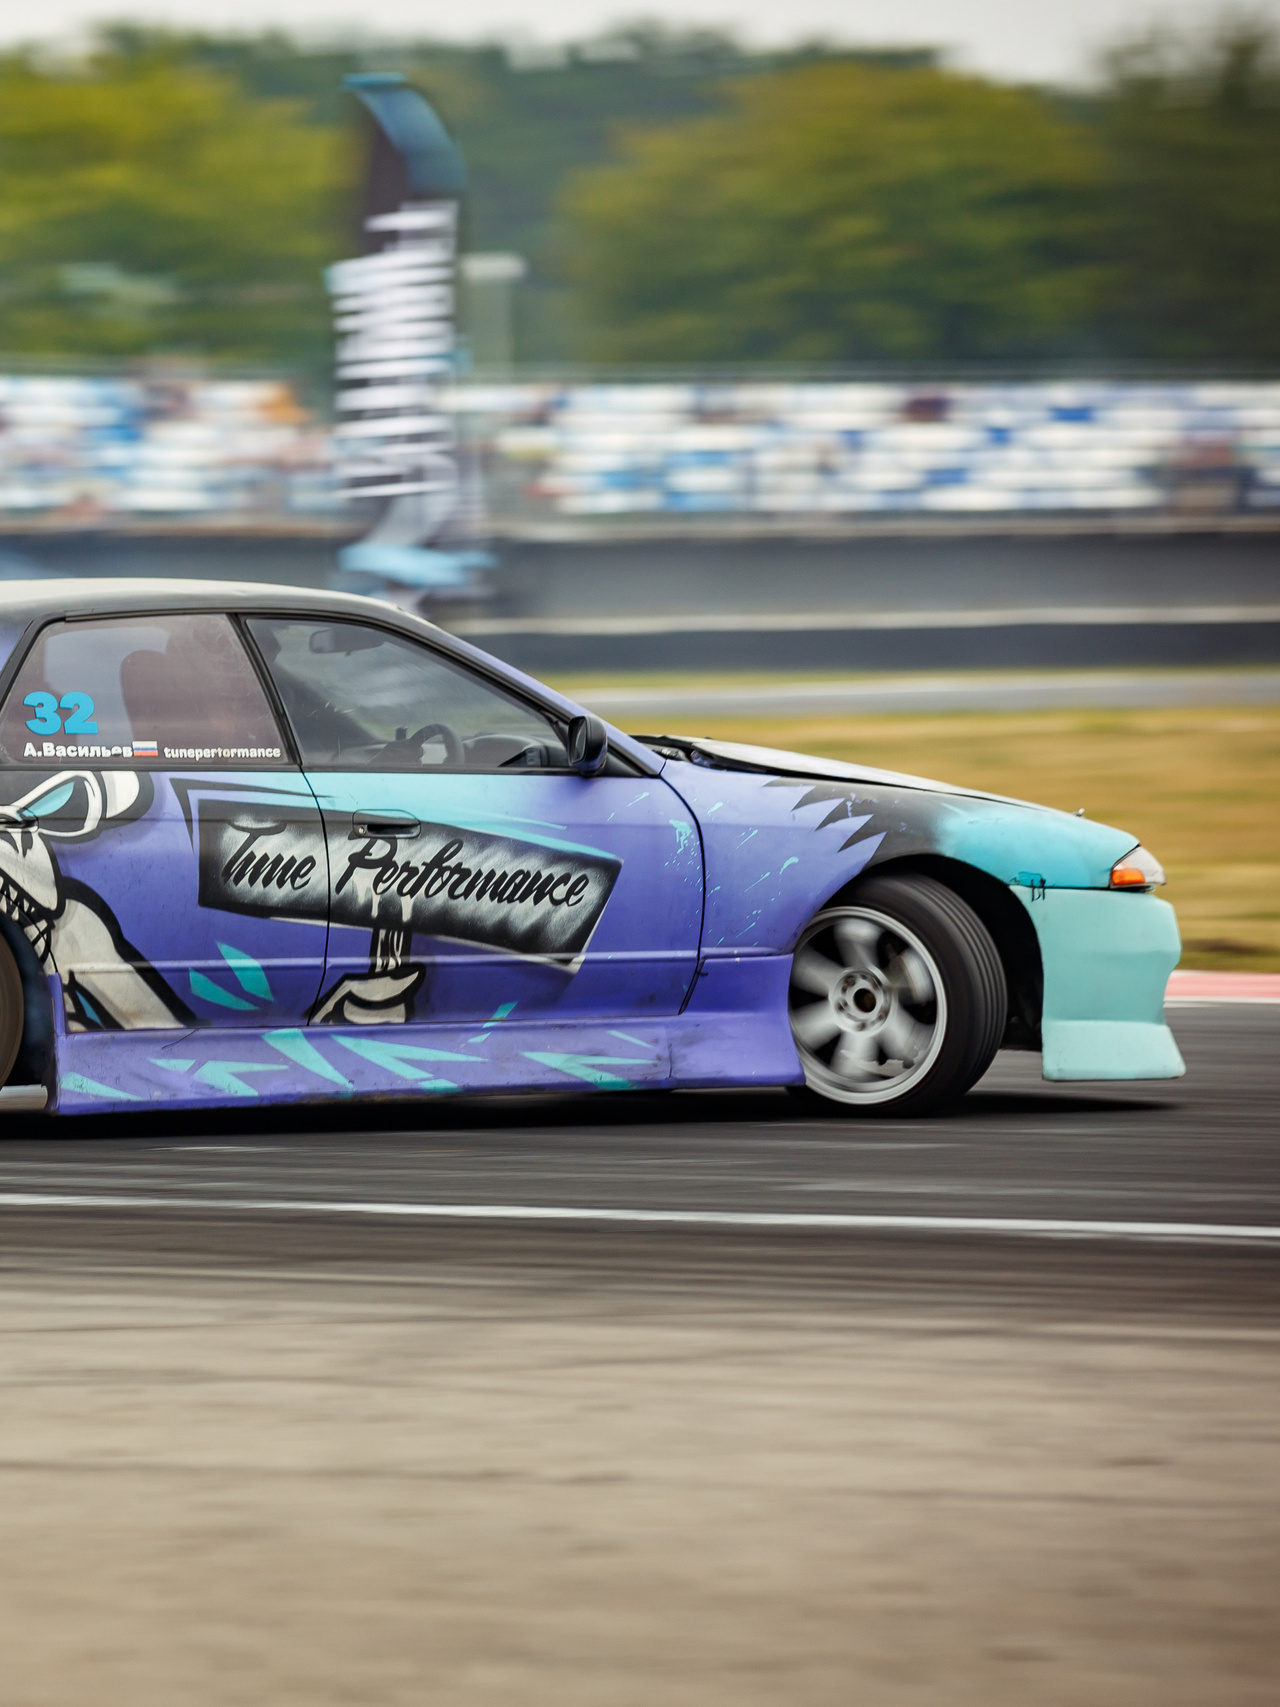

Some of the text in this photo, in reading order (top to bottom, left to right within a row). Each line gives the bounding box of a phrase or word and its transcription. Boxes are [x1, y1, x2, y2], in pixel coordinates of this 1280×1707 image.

[23, 691, 99, 735] 32
[163, 746, 282, 761] tuneperformance
[220, 820, 590, 908] Tune Performance
